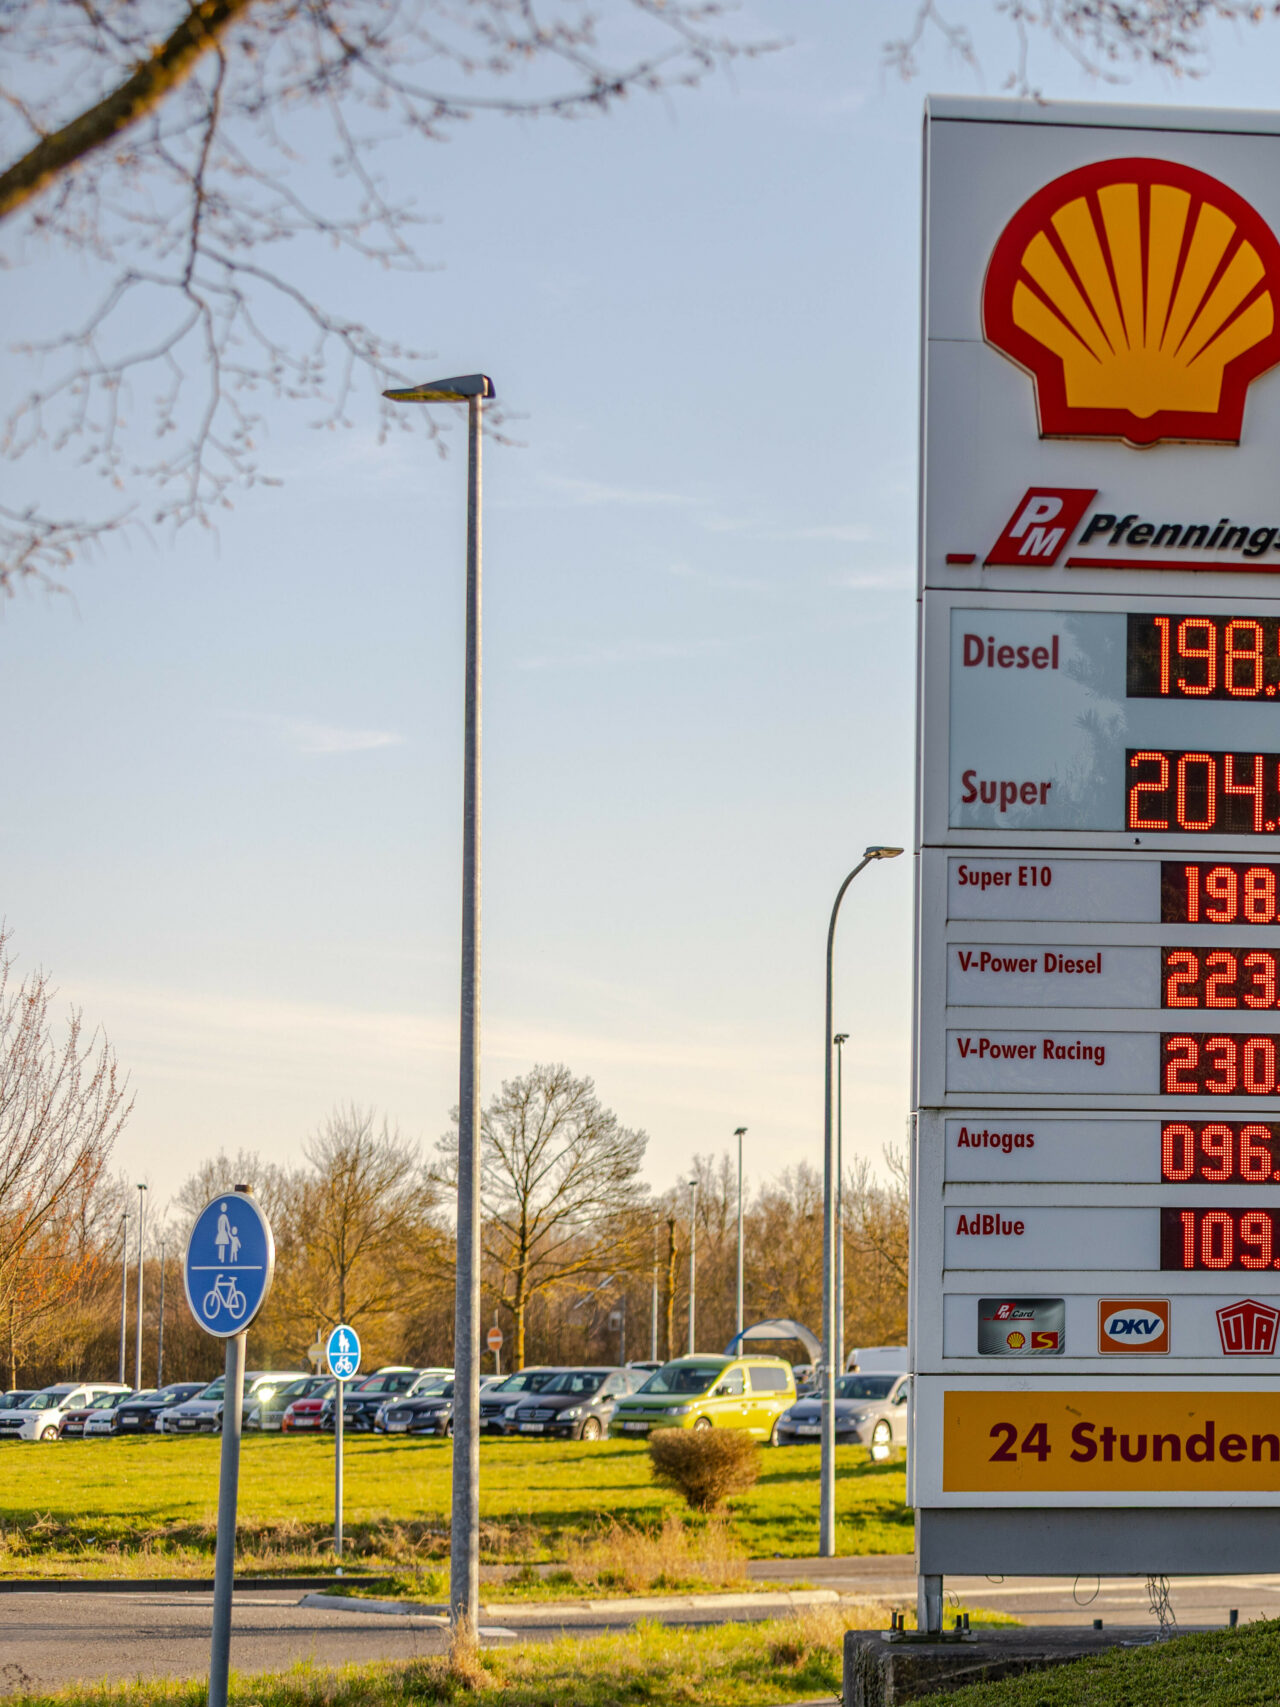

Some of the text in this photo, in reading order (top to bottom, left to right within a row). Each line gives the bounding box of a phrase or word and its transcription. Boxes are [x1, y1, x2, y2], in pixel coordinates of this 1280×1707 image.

[962, 633, 1059, 670] Diesel
[960, 769, 1052, 813] Super
[957, 865, 1012, 891] Super
[1018, 866, 1052, 888] E10
[958, 950, 1038, 974] V-Power
[1043, 952, 1102, 975] Diesel
[956, 1037, 1038, 1060] V-Power
[1042, 1038, 1106, 1066] Racing
[957, 1127, 1035, 1154] Autogas
[956, 1213, 1025, 1236] AdBlue
[1012, 1310, 1035, 1318] Card
[1108, 1319, 1161, 1335] DKV
[988, 1420, 1280, 1463] 24 Stunden
